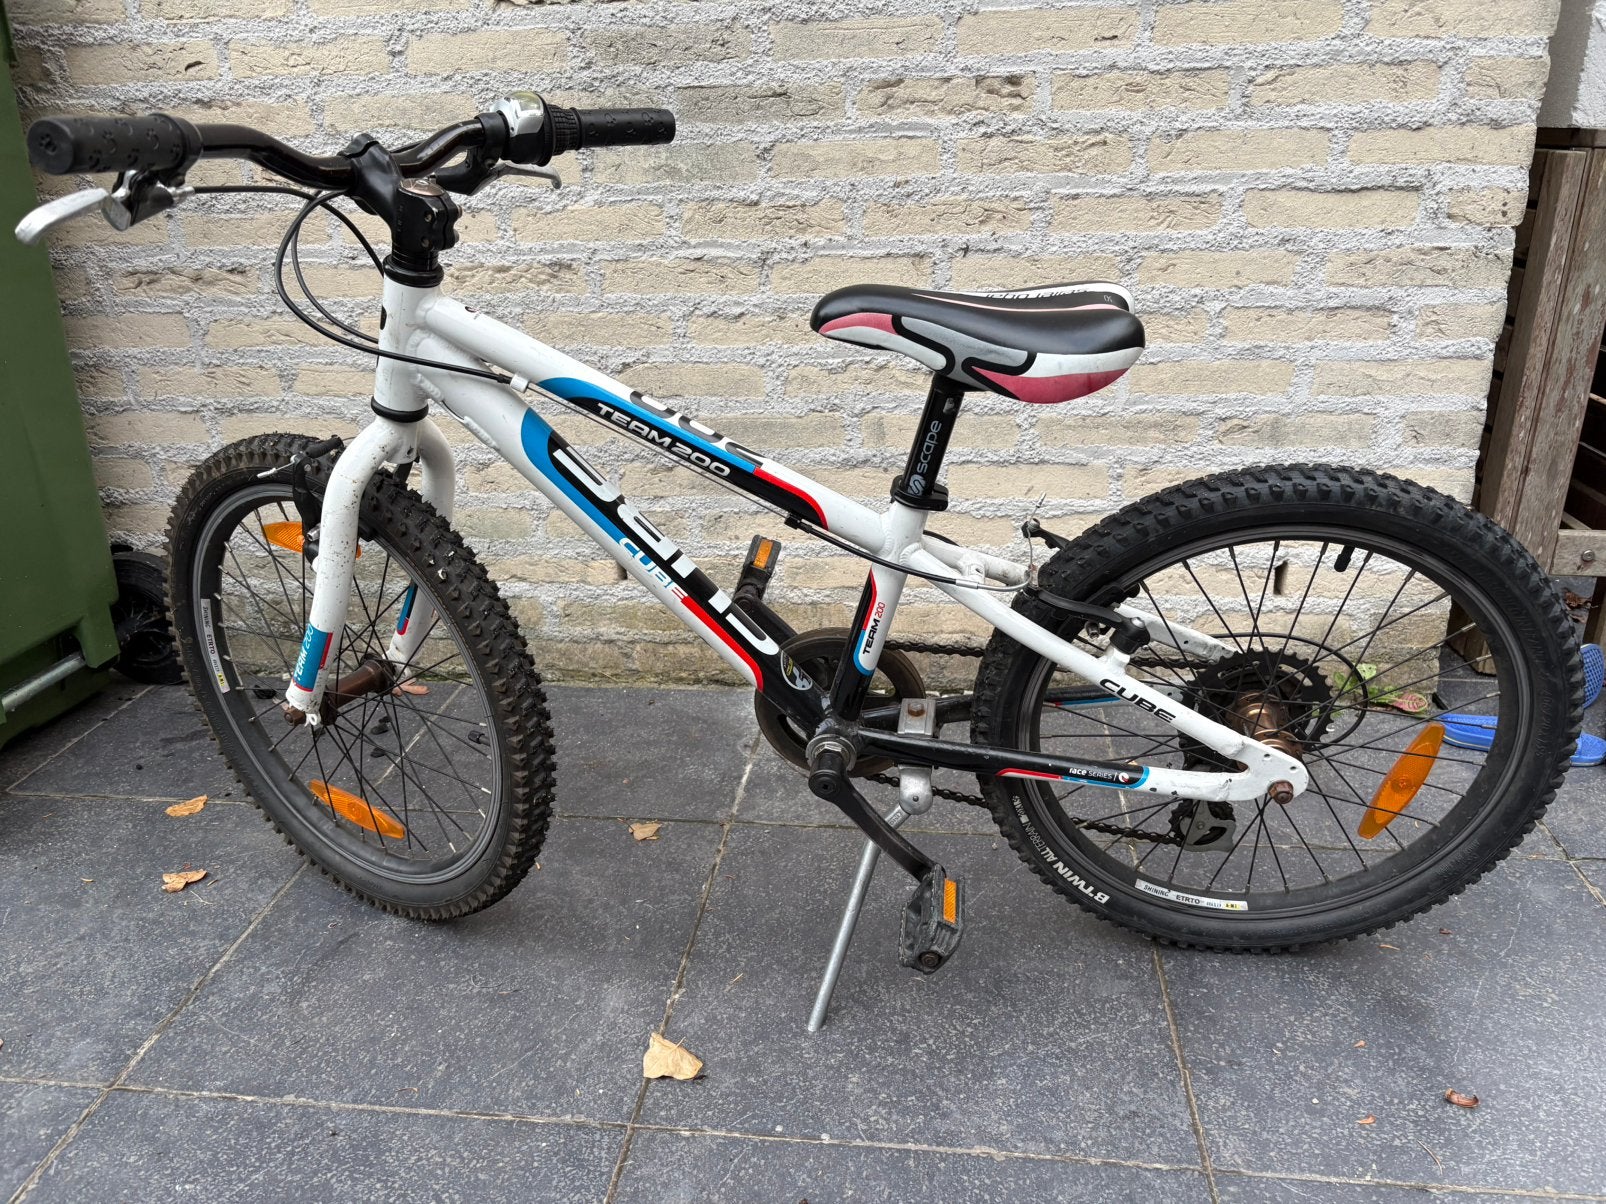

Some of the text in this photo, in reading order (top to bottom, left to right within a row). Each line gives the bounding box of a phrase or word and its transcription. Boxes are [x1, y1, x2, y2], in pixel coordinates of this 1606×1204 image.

[917, 420, 942, 474] scape
[619, 537, 689, 602] CUBE
[206, 634, 216, 655] ETRTO
[863, 601, 886, 655] TEAM 200
[294, 623, 315, 681] TEAM 200
[1099, 678, 1176, 724] CUBE
[1068, 767, 1113, 780] race SERIES
[1052, 860, 1111, 905] B'TWIN
[1143, 884, 1169, 897] SHINING
[1175, 894, 1201, 905] ETRTO
